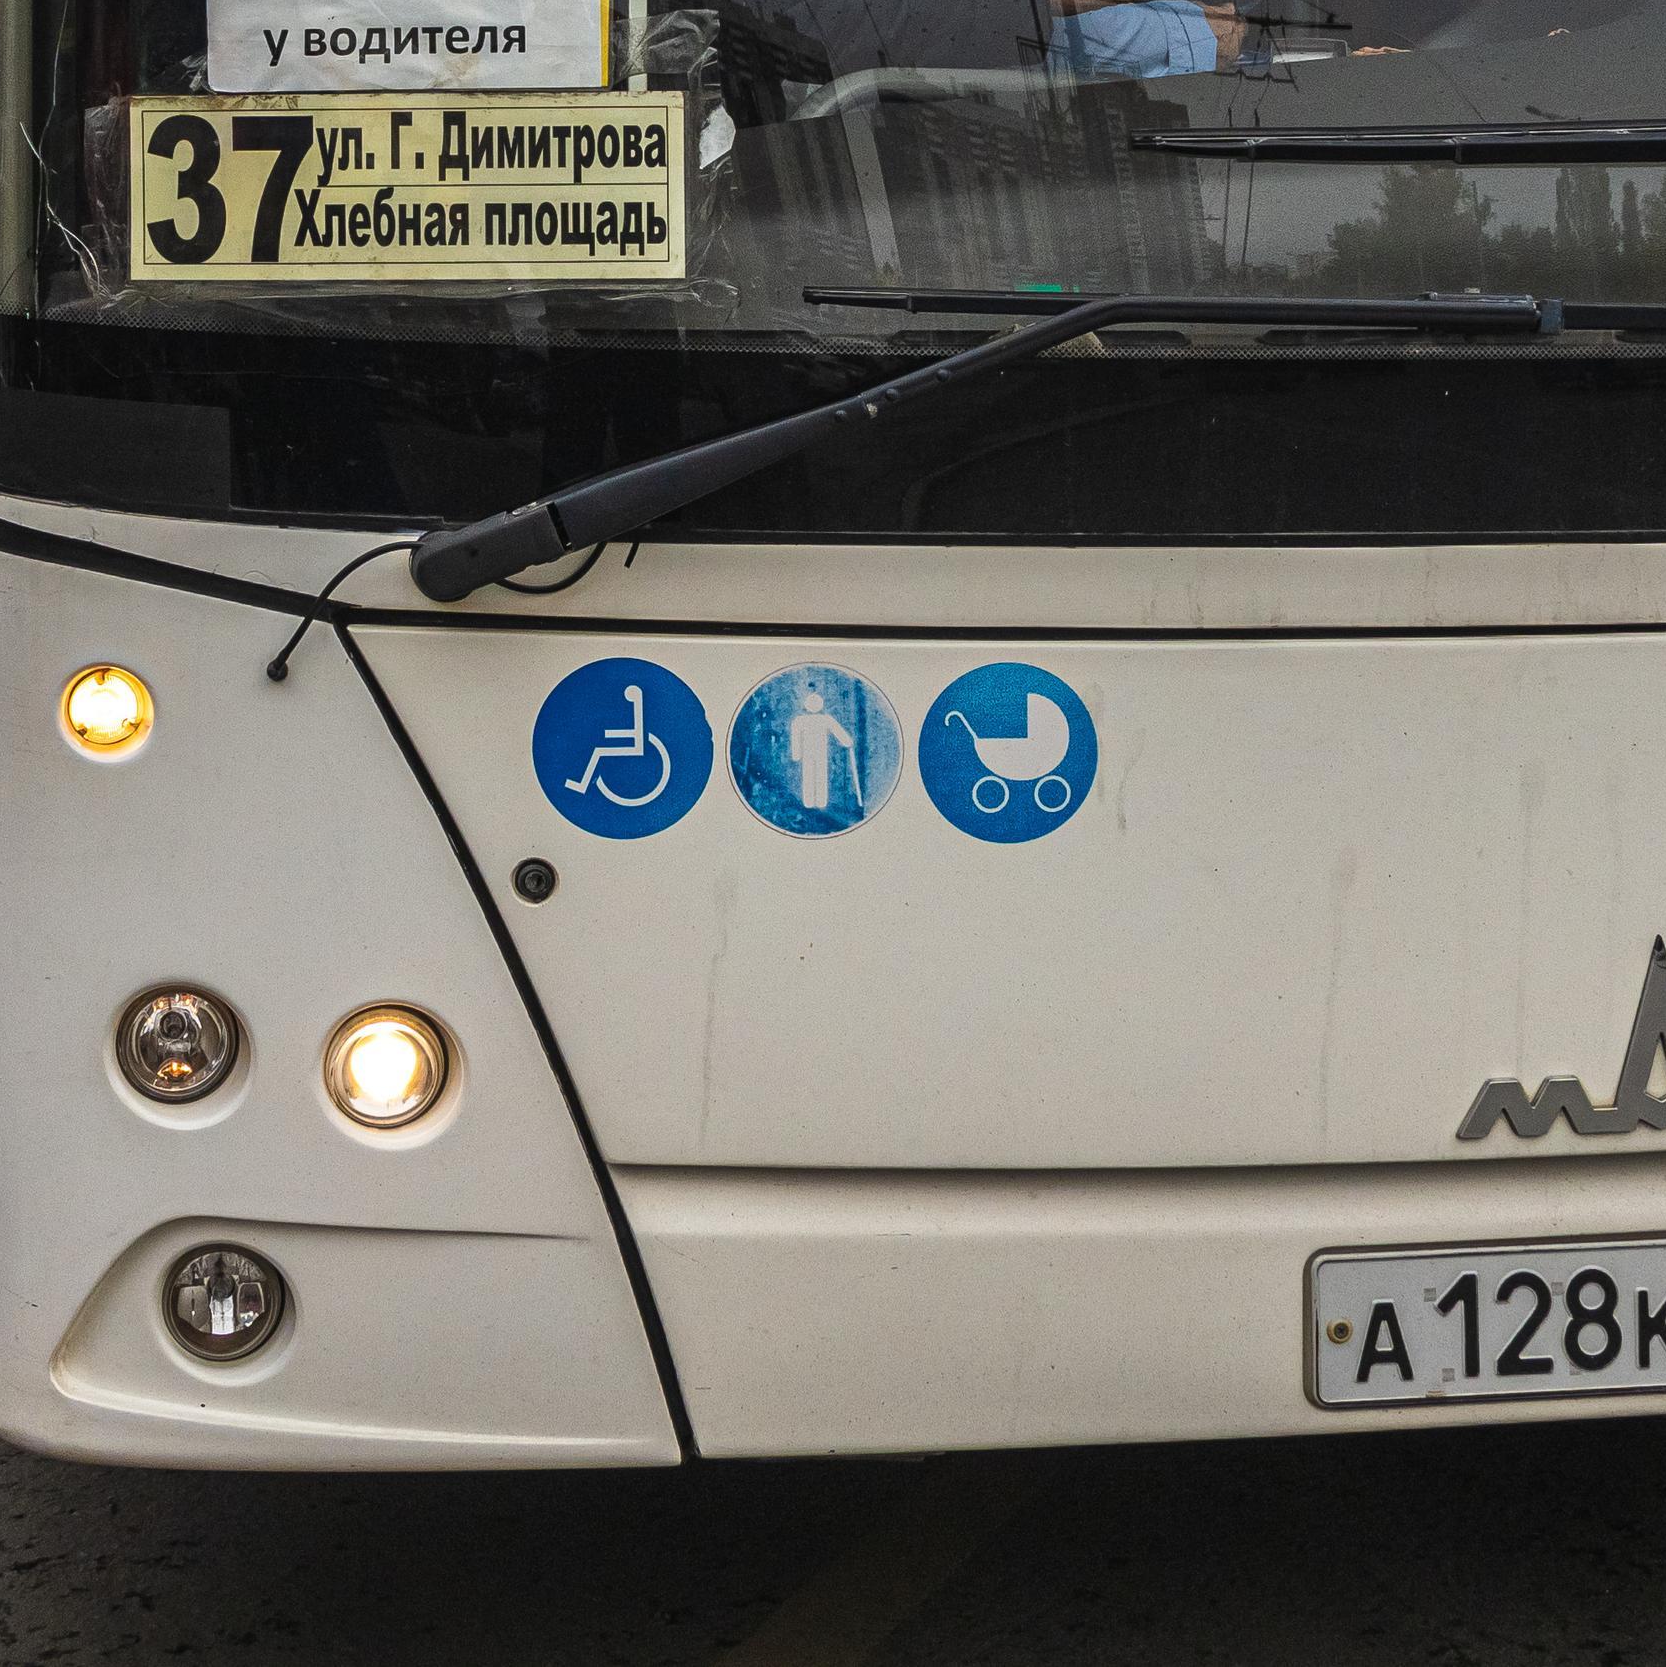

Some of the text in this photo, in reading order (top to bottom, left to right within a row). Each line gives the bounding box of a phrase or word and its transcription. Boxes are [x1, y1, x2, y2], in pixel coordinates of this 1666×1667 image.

[263, 19, 528, 66] у водителя
[316, 110, 667, 187] ул. Г. Димитрова
[146, 113, 315, 264] 37
[294, 187, 668, 260] Хлебная площадь
